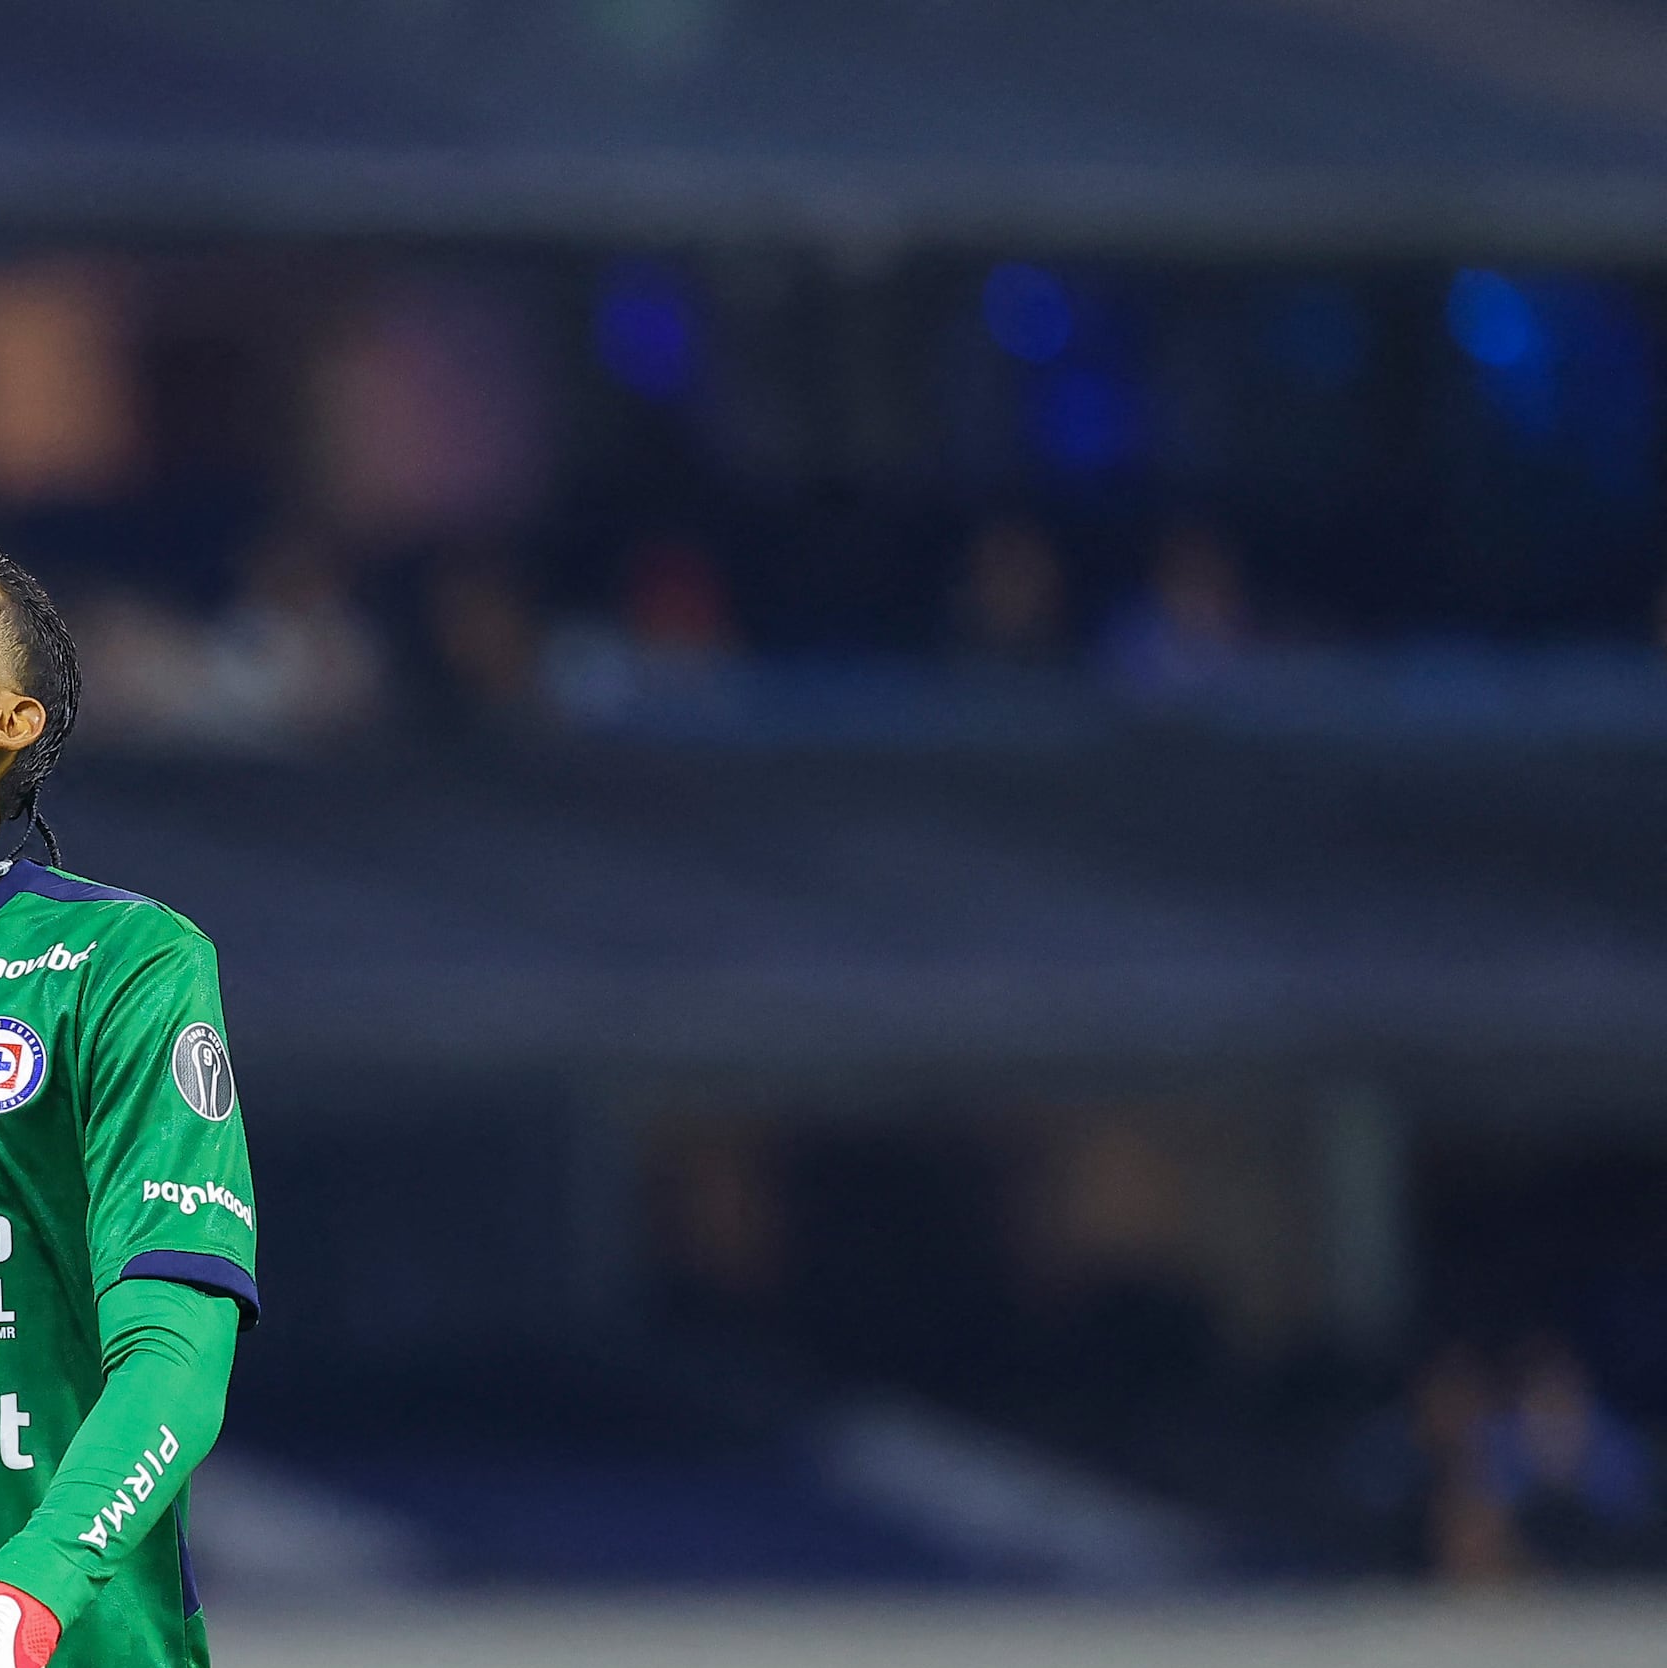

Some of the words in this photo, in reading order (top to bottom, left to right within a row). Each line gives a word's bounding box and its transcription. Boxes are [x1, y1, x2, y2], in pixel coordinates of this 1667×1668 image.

[9, 1022, 43, 1060] FUTBOL
[202, 1046, 214, 1068] 9
[77, 1423, 180, 1550] PIRMA
